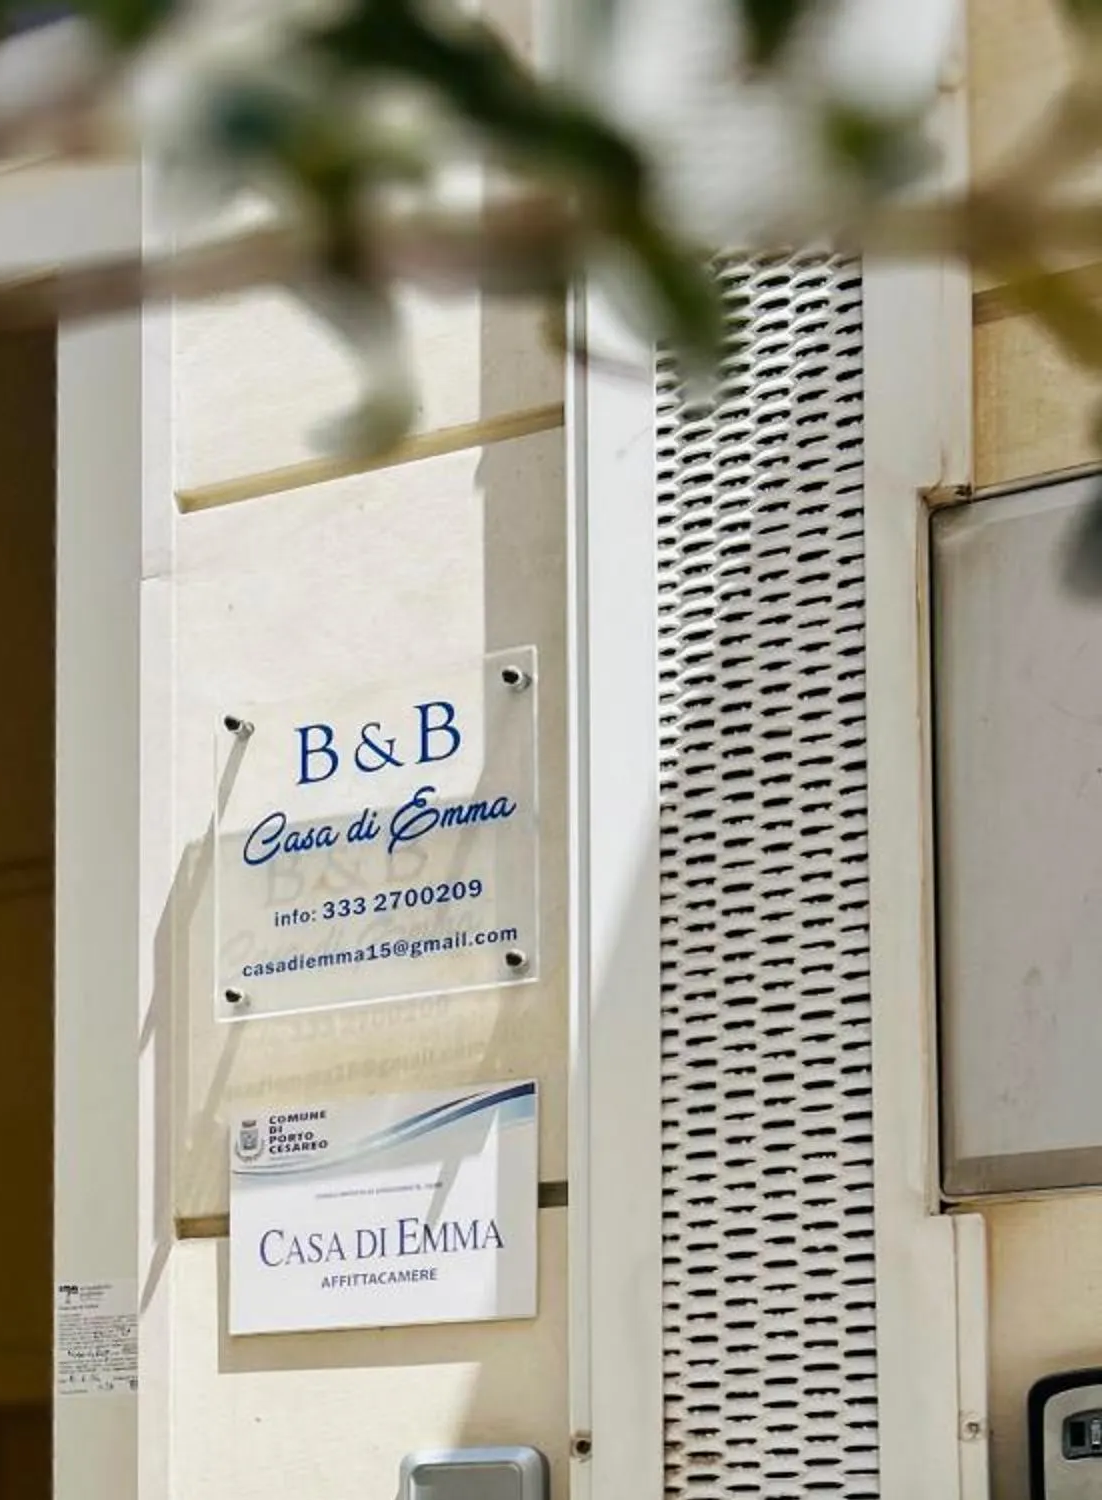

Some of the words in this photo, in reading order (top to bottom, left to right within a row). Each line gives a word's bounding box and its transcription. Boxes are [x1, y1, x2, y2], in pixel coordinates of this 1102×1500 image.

[243, 811, 340, 866] Casa
[347, 808, 381, 843] di
[388, 785, 518, 855] Emma
[273, 909, 317, 928] info:
[322, 896, 367, 920] 333
[373, 879, 483, 914] 2700209
[241, 925, 518, 977] casadiemma15@gmail.com
[268, 1110, 327, 1125] COMUNE
[268, 1125, 283, 1134] DI
[268, 1131, 315, 1144] PORTO
[268, 1139, 329, 1154] CESAREO
[259, 1229, 347, 1267] CASA
[355, 1227, 389, 1260] DI
[397, 1217, 505, 1257] EMMA
[321, 1267, 438, 1289] AFFITTACAMERE
